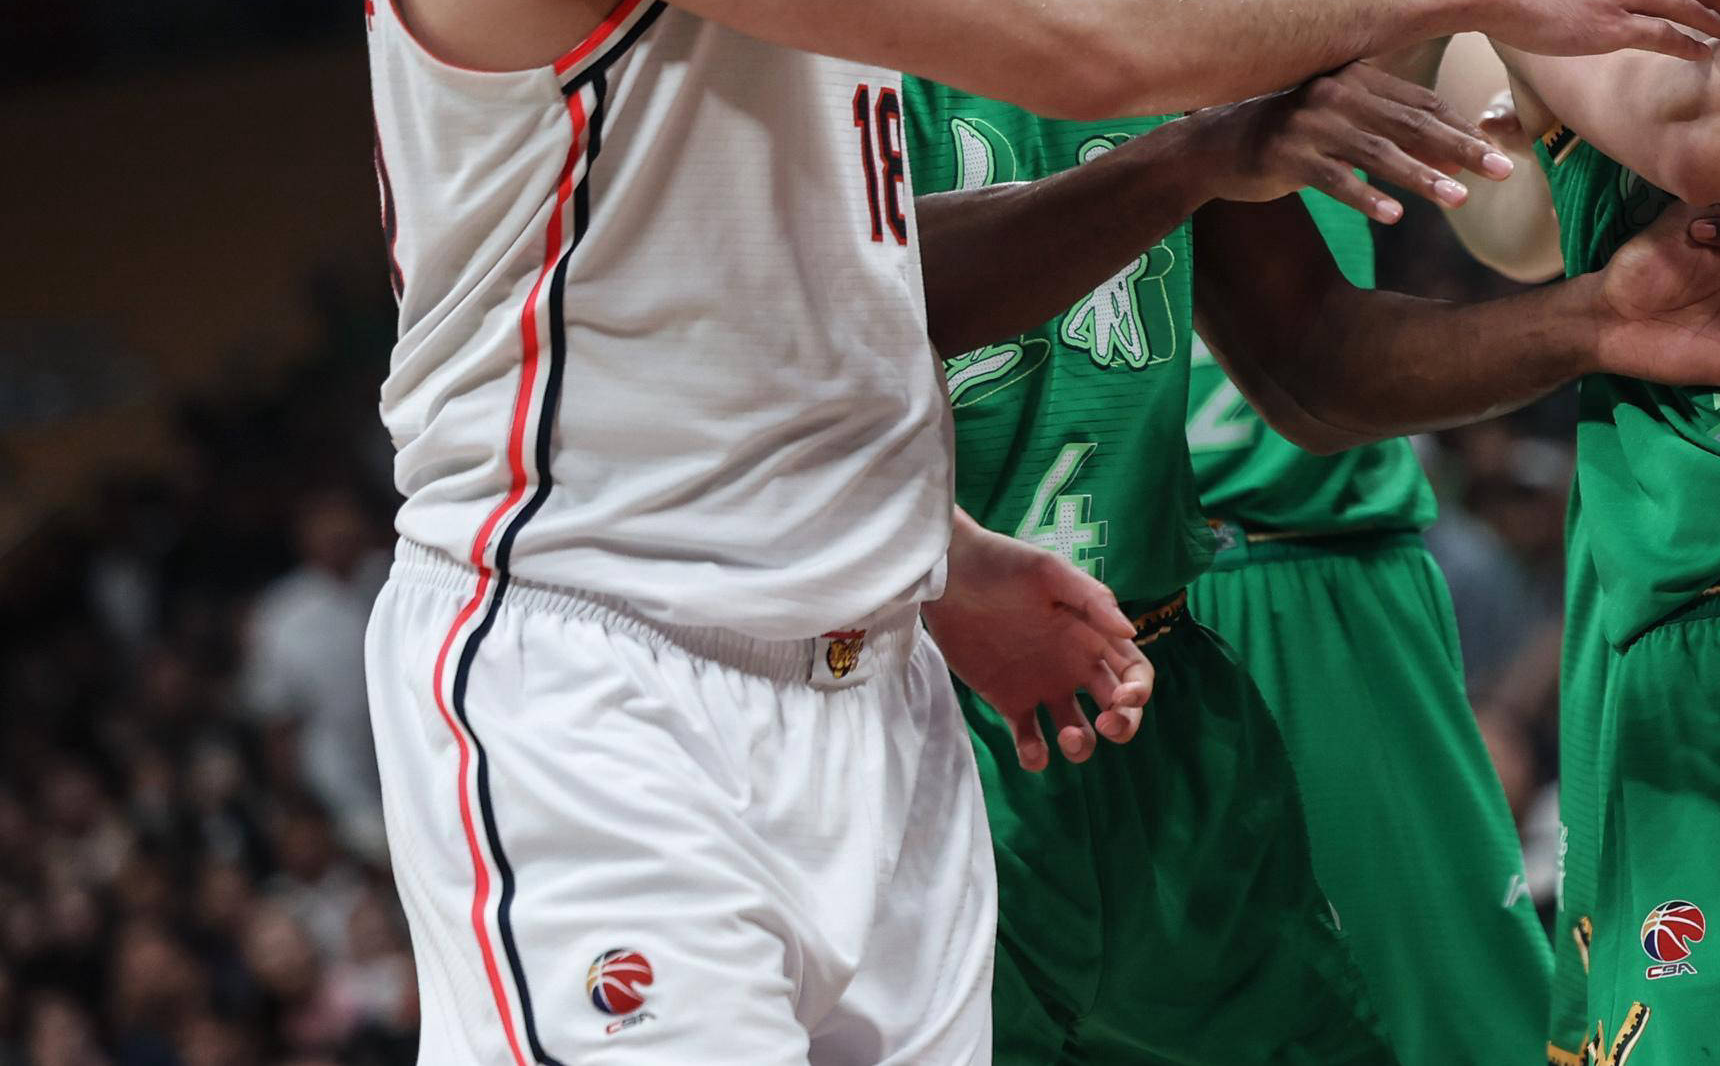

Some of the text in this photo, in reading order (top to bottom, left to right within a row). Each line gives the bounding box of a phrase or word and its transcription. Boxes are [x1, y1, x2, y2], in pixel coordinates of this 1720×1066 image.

[852, 84, 908, 246] 18
[1014, 442, 1108, 584] 4
[1646, 962, 1698, 980] CBA
